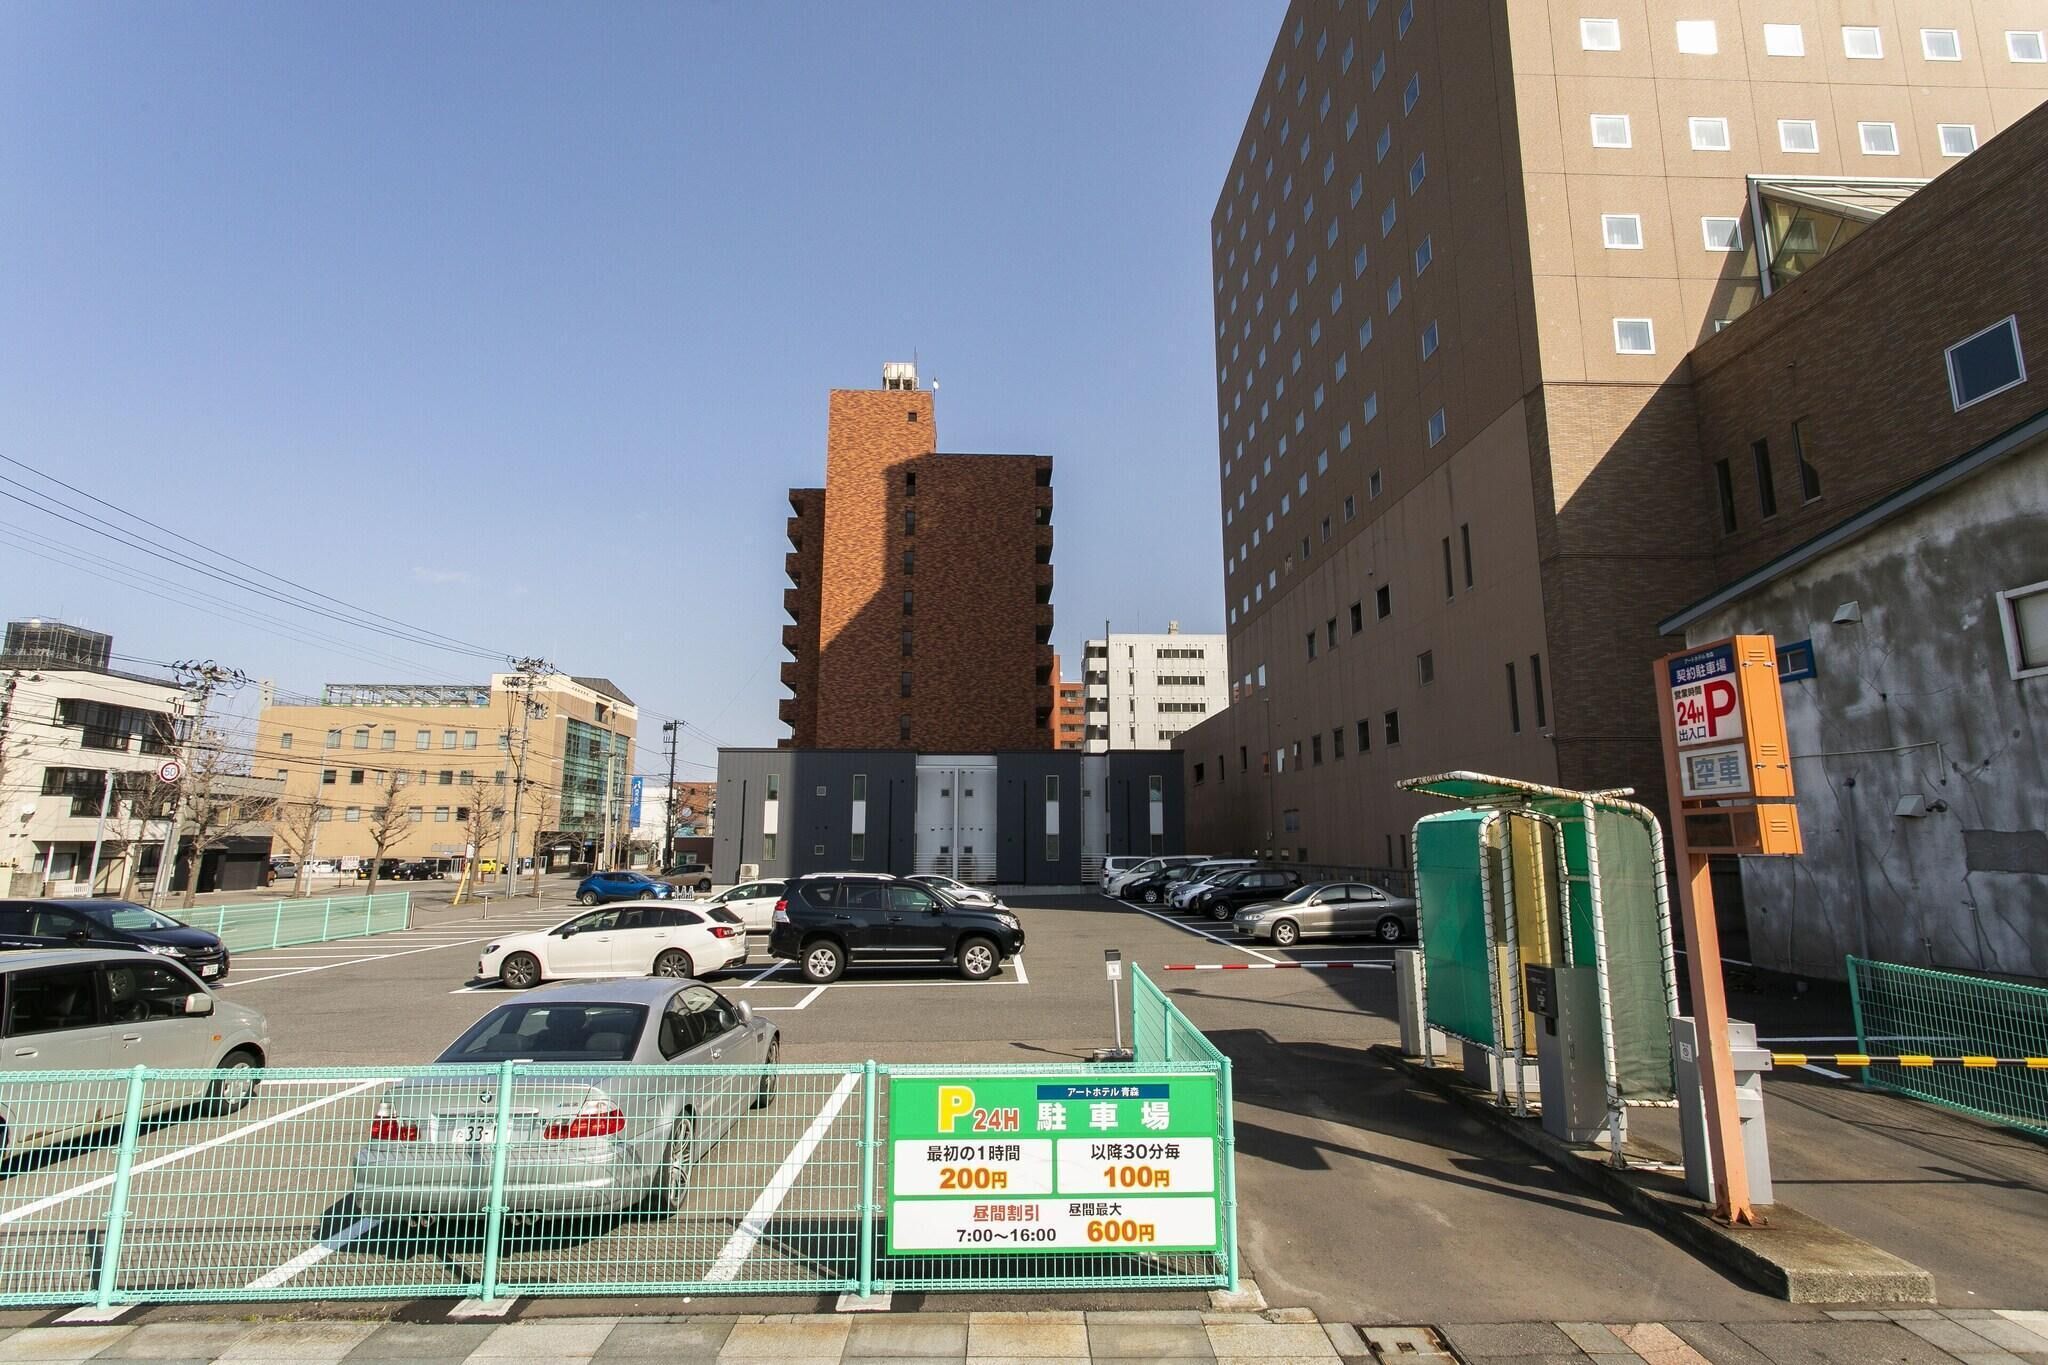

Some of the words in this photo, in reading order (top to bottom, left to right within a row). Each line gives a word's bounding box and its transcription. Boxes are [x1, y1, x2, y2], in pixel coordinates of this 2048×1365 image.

[1676, 658, 1727, 683] 契約駐車場
[1677, 699, 1705, 726] 24H
[1704, 680, 1736, 737] P
[1679, 726, 1706, 742] 出入口
[165, 767, 176, 777] 50
[1695, 756, 1742, 787] 空車
[938, 1086, 976, 1133] P
[973, 1108, 1020, 1132] 24H
[1037, 1101, 1170, 1131] 駐車場
[927, 1145, 1020, 1162] 最初の1時間
[1091, 1144, 1180, 1161] 以降30分毎
[939, 1167, 1008, 1190] 200円
[1103, 1166, 1171, 1188] 100円
[973, 1204, 1040, 1223] 昼間割引
[1068, 1202, 1122, 1217] 昼間最大
[1087, 1221, 1155, 1242] 600円
